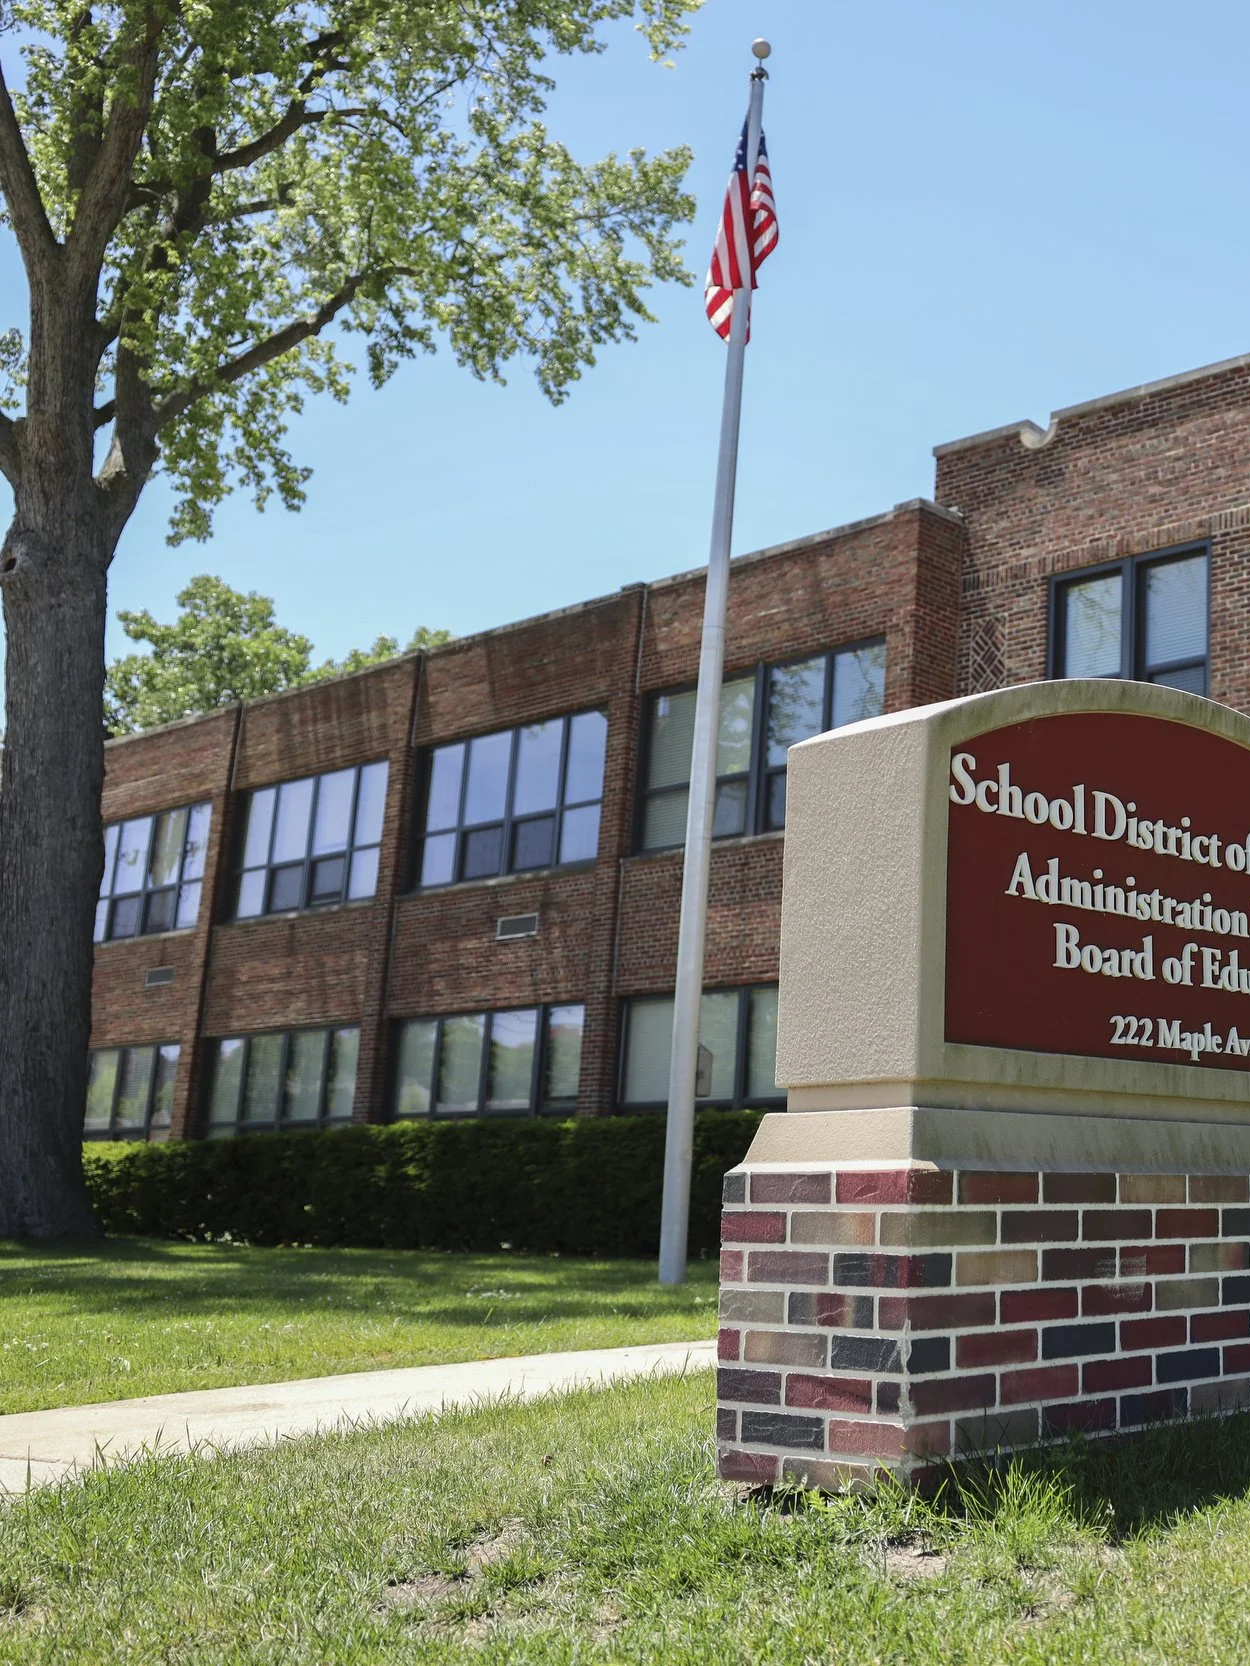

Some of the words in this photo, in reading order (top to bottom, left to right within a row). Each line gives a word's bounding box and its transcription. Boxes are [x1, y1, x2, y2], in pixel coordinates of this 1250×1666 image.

[950, 753, 1087, 835] School
[1092, 791, 1222, 868] District
[1005, 852, 1249, 938] Administration
[1053, 923, 1155, 981] Board
[1162, 943, 1198, 986] of
[1110, 1016, 1154, 1047] 222
[1157, 1019, 1223, 1061] Maple
